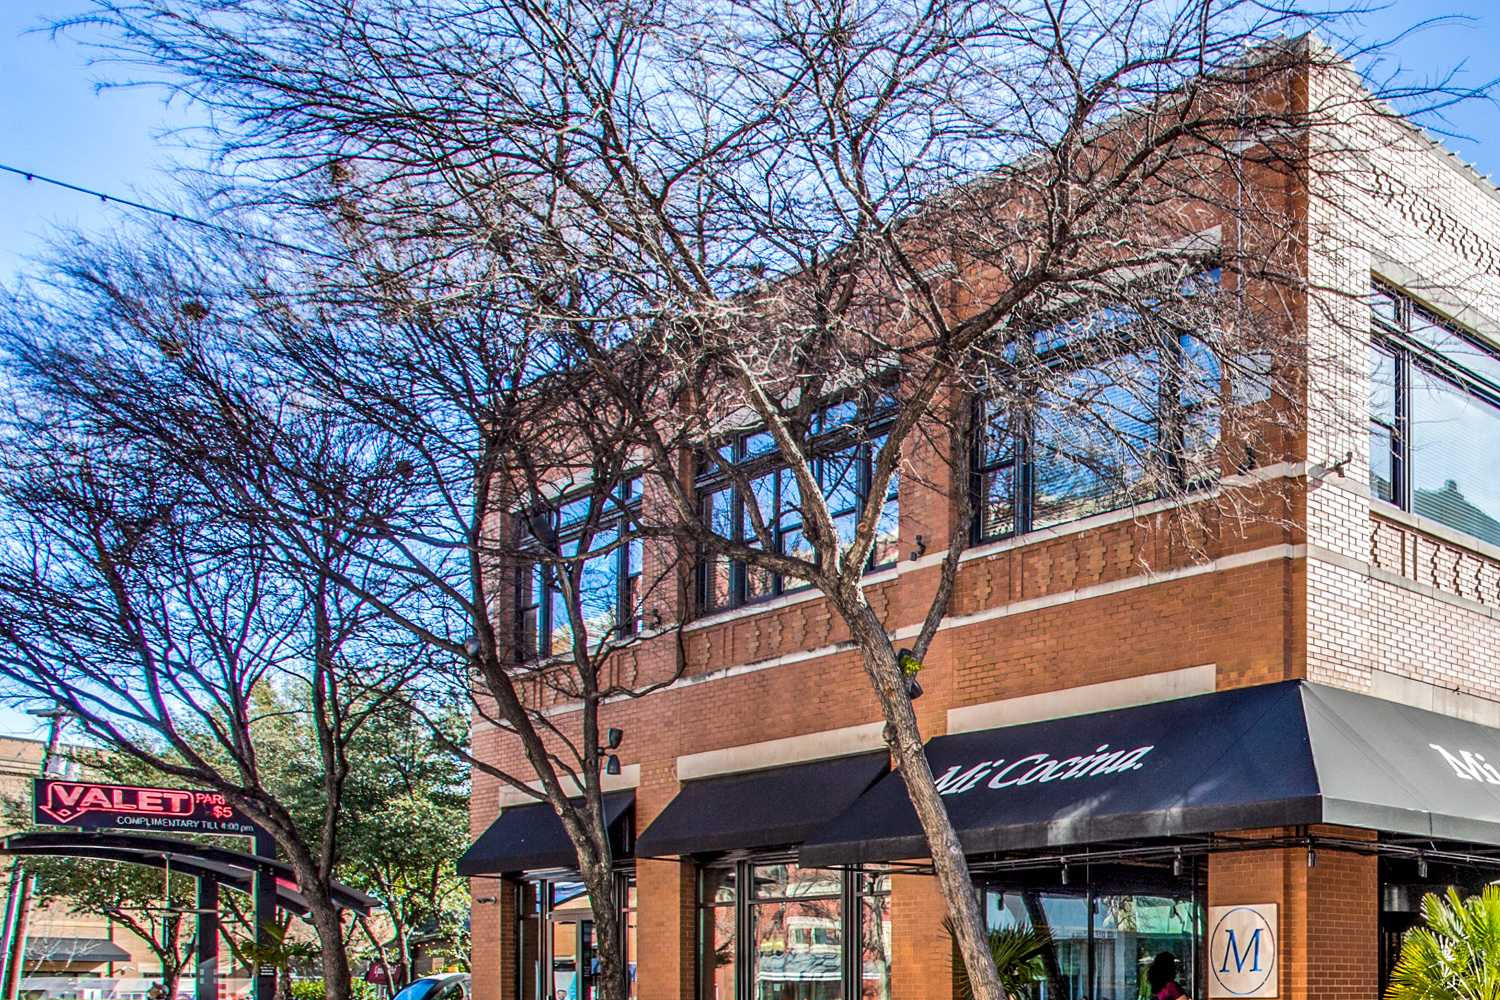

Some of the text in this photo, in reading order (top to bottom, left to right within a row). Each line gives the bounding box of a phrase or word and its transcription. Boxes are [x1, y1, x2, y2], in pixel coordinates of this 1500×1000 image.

[934, 759, 1005, 796] Mi
[52, 784, 189, 814] VALET
[212, 805, 233, 819] $5
[117, 815, 200, 828] COMPLIMENTARY
[1218, 927, 1265, 974] M
